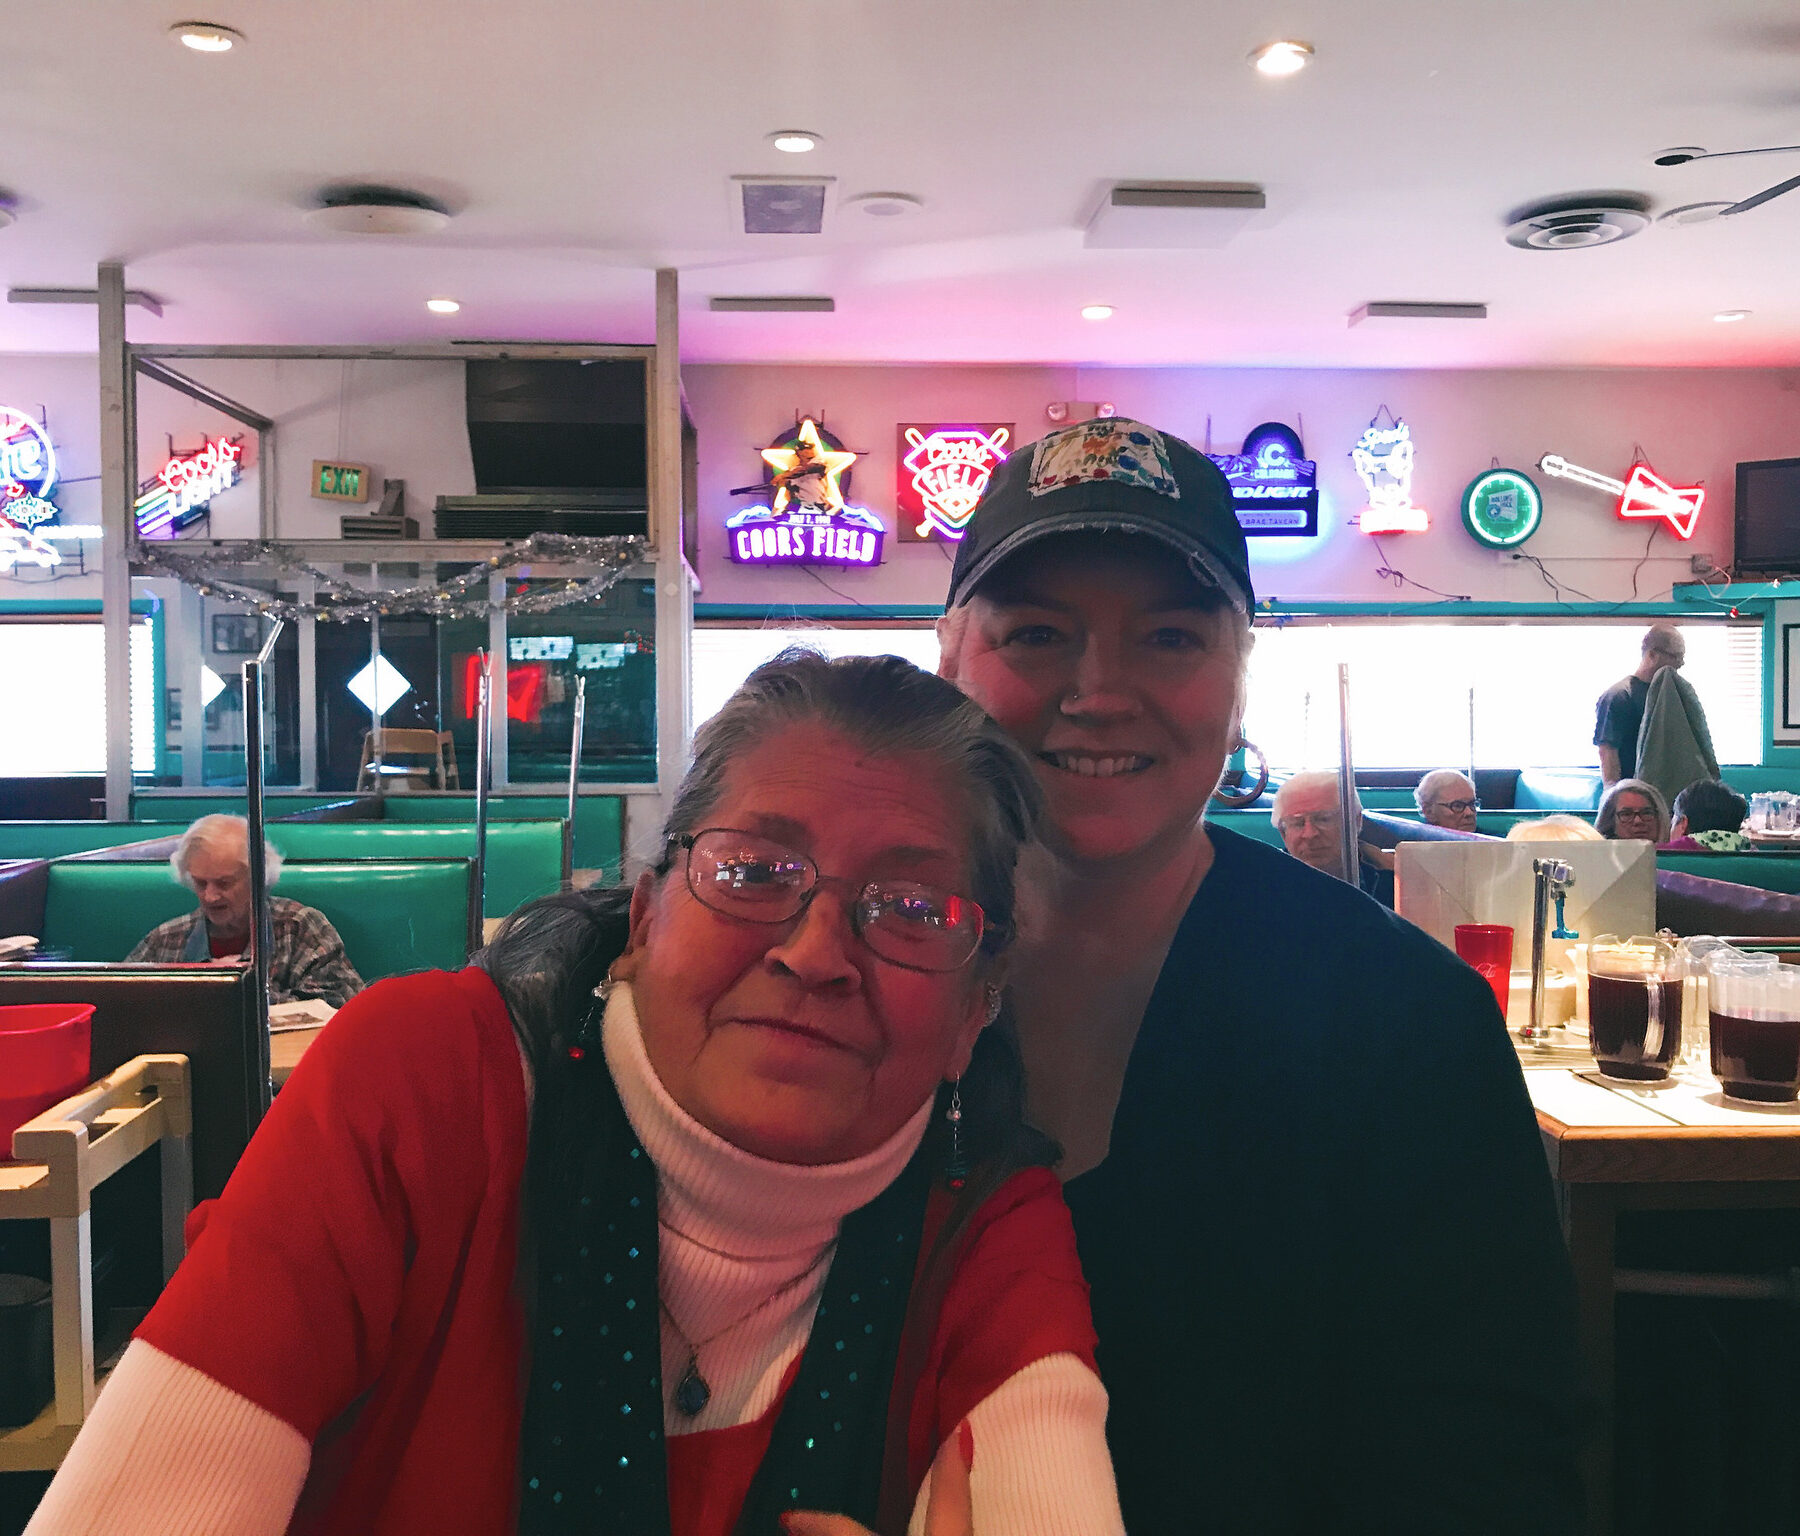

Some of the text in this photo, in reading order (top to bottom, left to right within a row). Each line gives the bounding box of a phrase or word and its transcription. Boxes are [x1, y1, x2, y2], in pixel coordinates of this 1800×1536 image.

[158, 437, 241, 492] Coors
[926, 438, 993, 463] Coors
[168, 460, 237, 517] LIGHT
[320, 465, 362, 497] EXIT
[921, 464, 989, 495] FIELD
[1268, 518, 1300, 526] TAVERN
[736, 526, 876, 562] COORS FIELD
